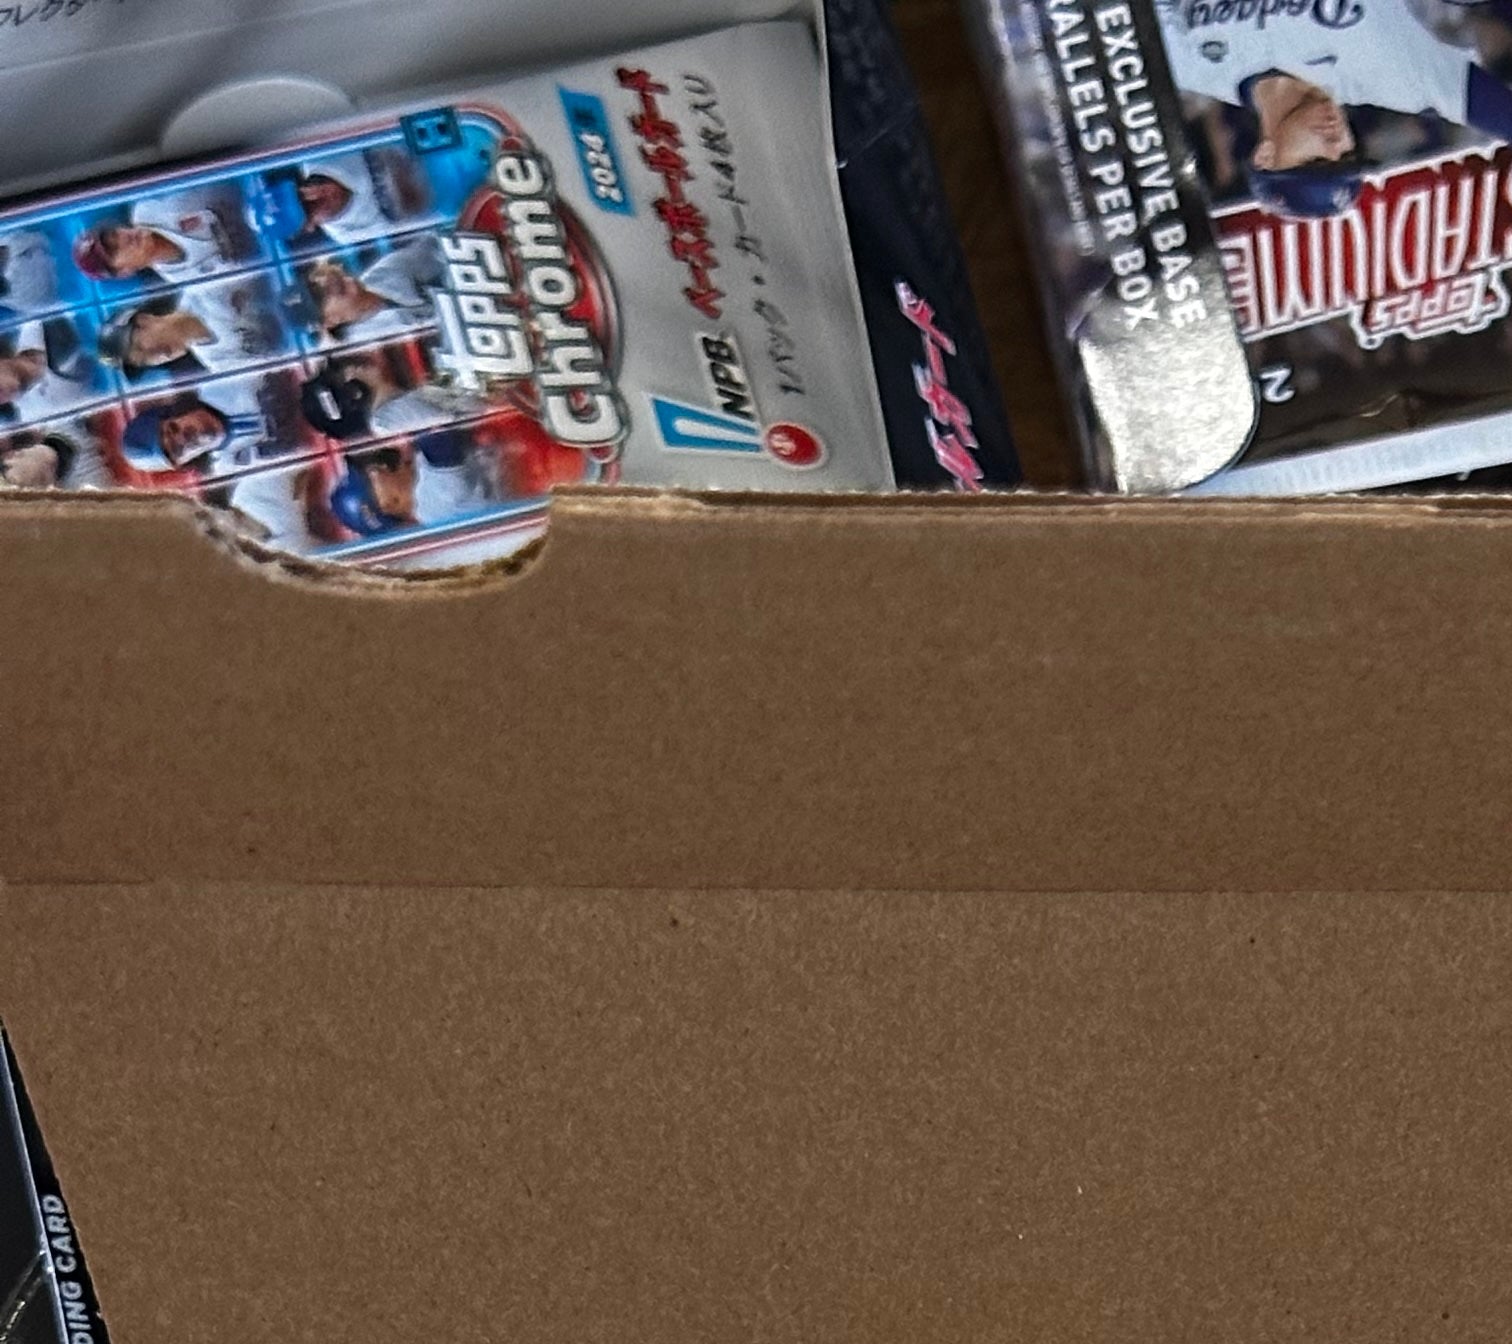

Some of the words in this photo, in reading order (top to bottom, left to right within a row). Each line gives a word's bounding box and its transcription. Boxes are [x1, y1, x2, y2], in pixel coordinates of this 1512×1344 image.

[1050, 0, 1117, 154] ALLELS
[1089, 160, 1138, 242] PER
[1094, 5, 1181, 222] EXCLUSIVE
[1152, 222, 1207, 329] BASE
[1110, 247, 1159, 330] BOX
[702, 334, 755, 421] NPB
[41, 1194, 76, 1273] CARD
